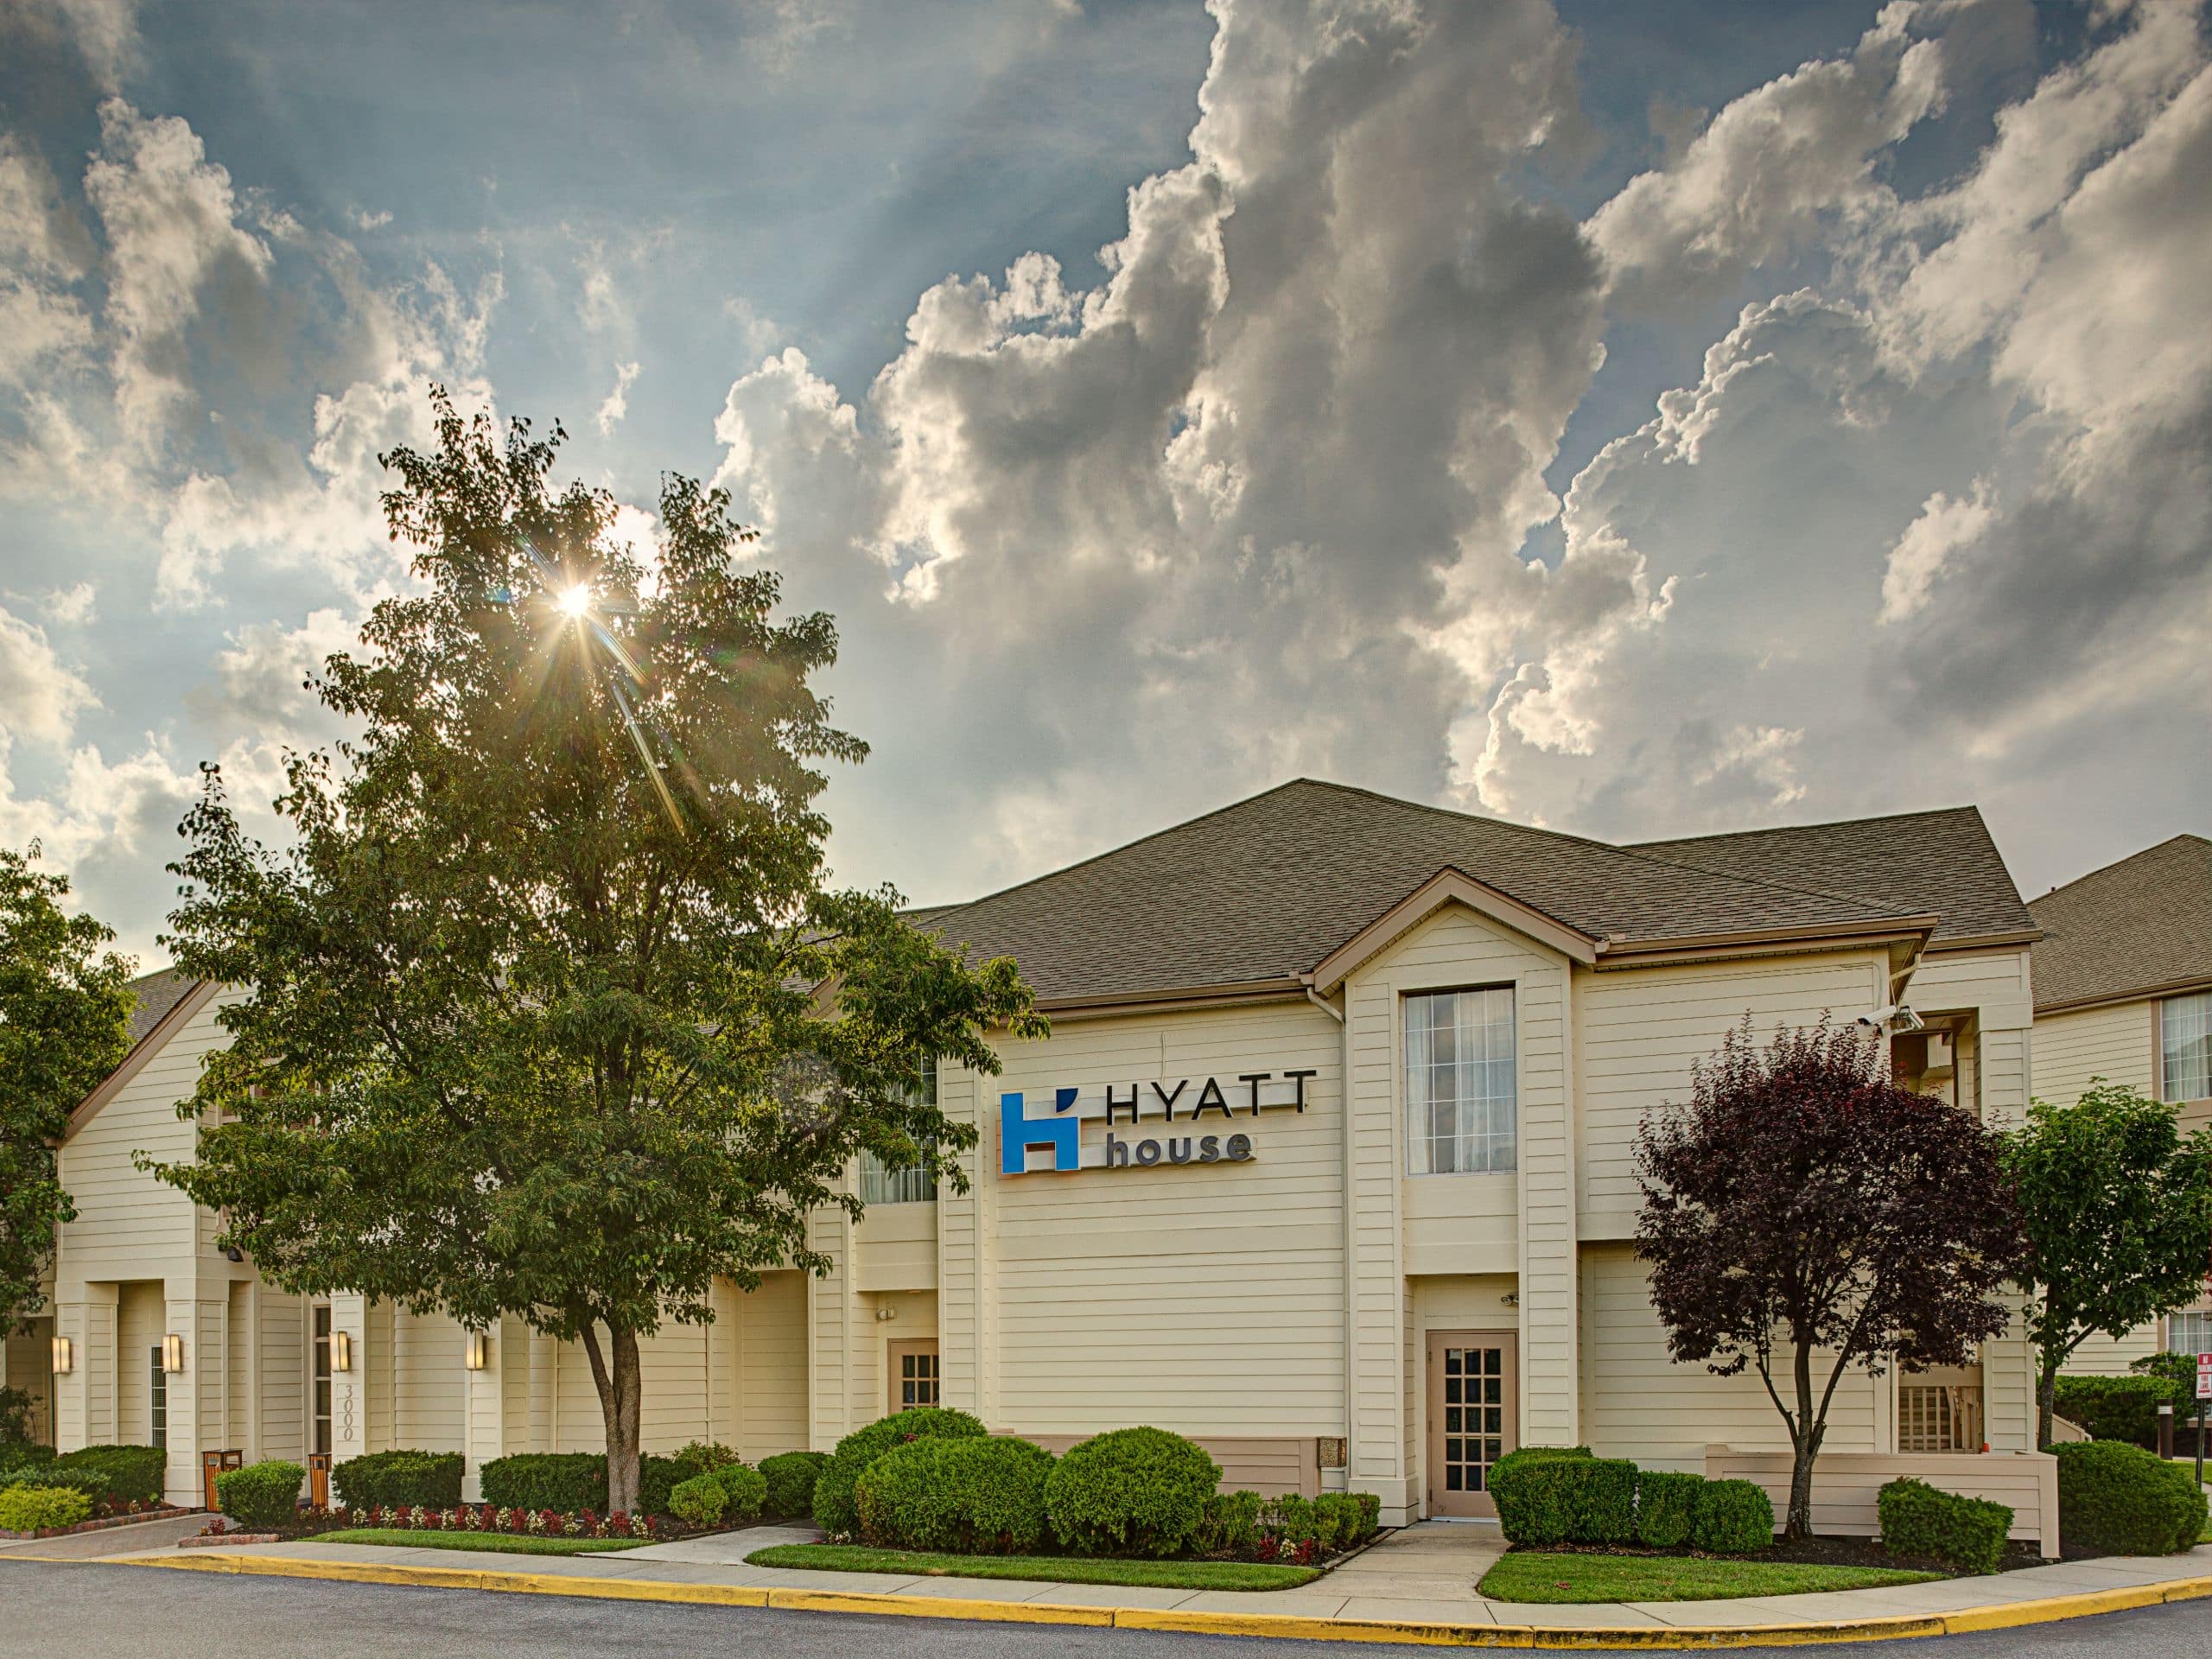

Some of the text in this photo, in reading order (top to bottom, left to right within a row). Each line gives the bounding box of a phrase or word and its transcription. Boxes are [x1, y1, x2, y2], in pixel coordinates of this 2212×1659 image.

[1106, 1070, 1317, 1126] HYATT
[1107, 1132, 1253, 1168] house
[345, 1384, 353, 1441] 3000
